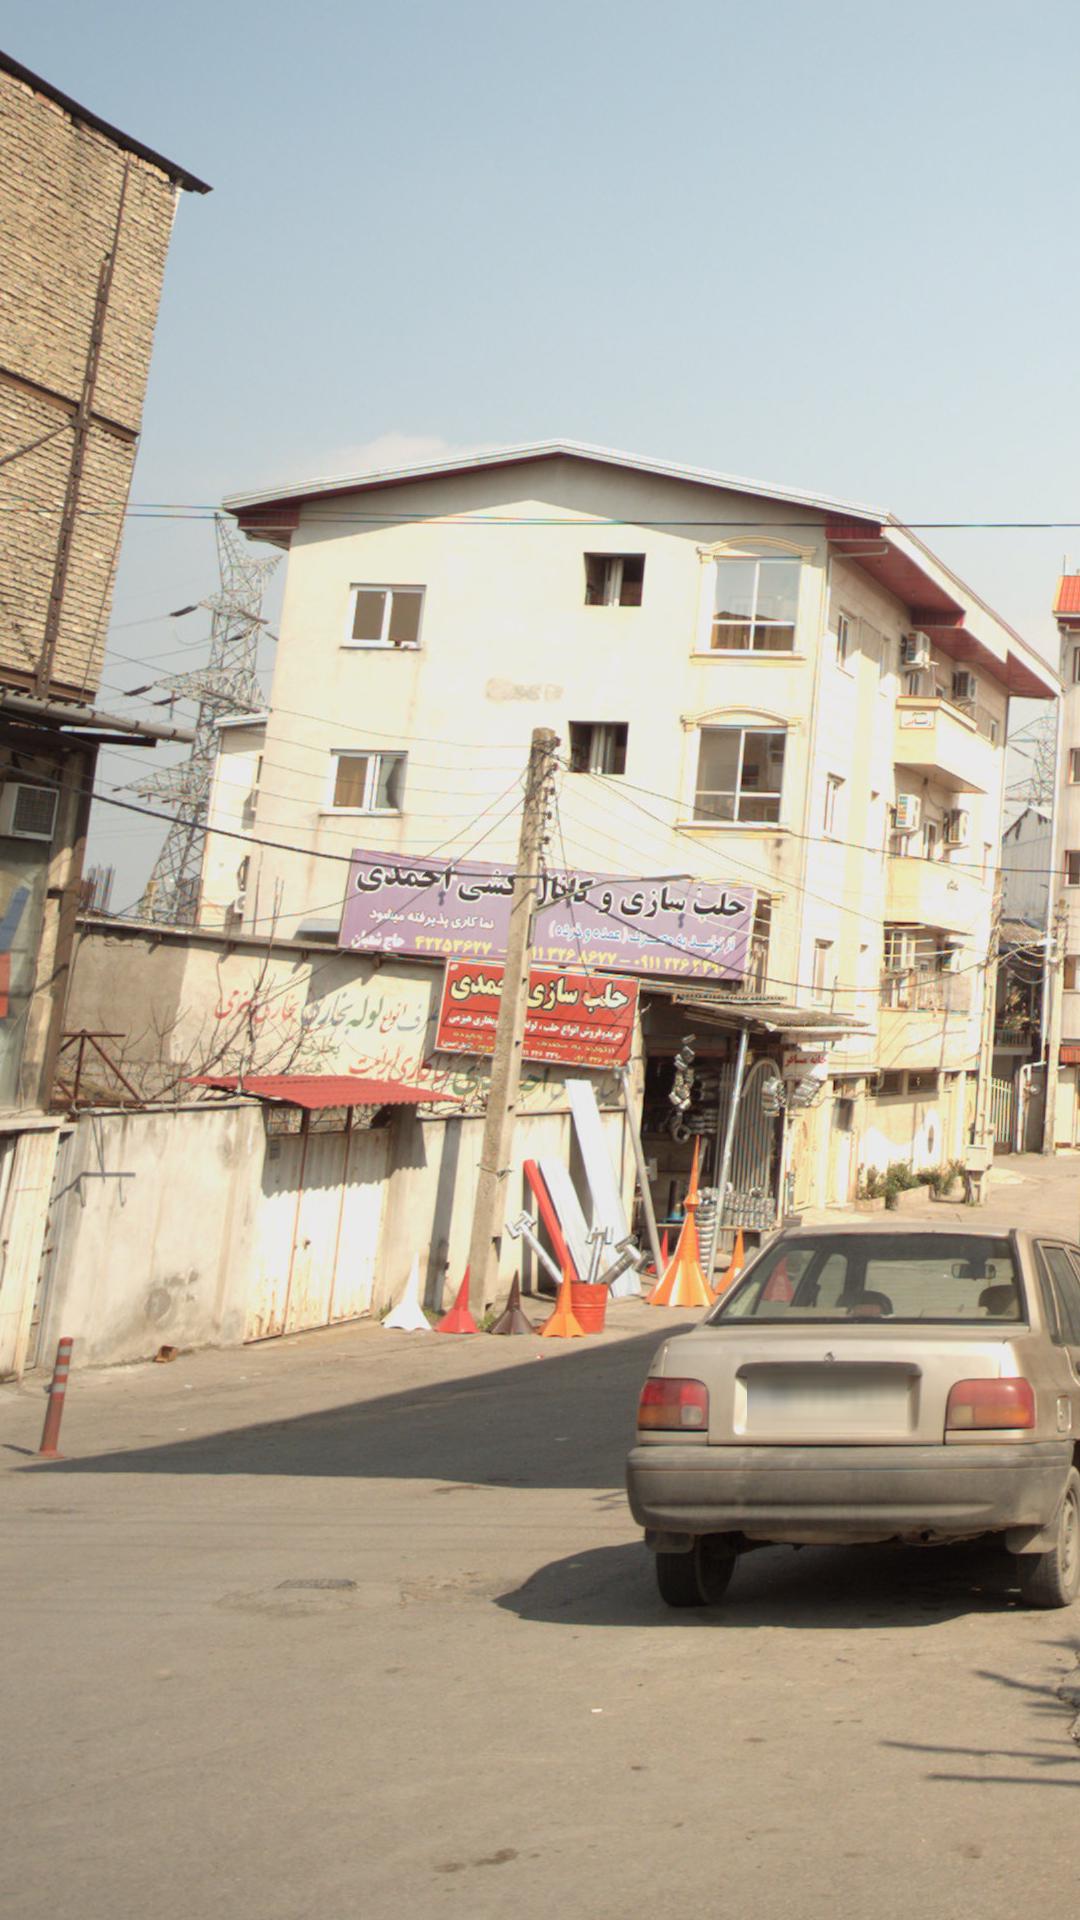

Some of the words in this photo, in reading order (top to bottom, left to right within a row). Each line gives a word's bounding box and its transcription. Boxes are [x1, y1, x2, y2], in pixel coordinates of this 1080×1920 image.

[356, 864, 457, 894] احمدی
[597, 890, 613, 915] و
[620, 884, 688, 919] سازی
[692, 890, 747, 921] حلب
[407, 911, 449, 929] پذیرفته
[527, 975, 580, 1011] سازی
[582, 981, 630, 1014] حلب
[346, 994, 385, 1029] لوله
